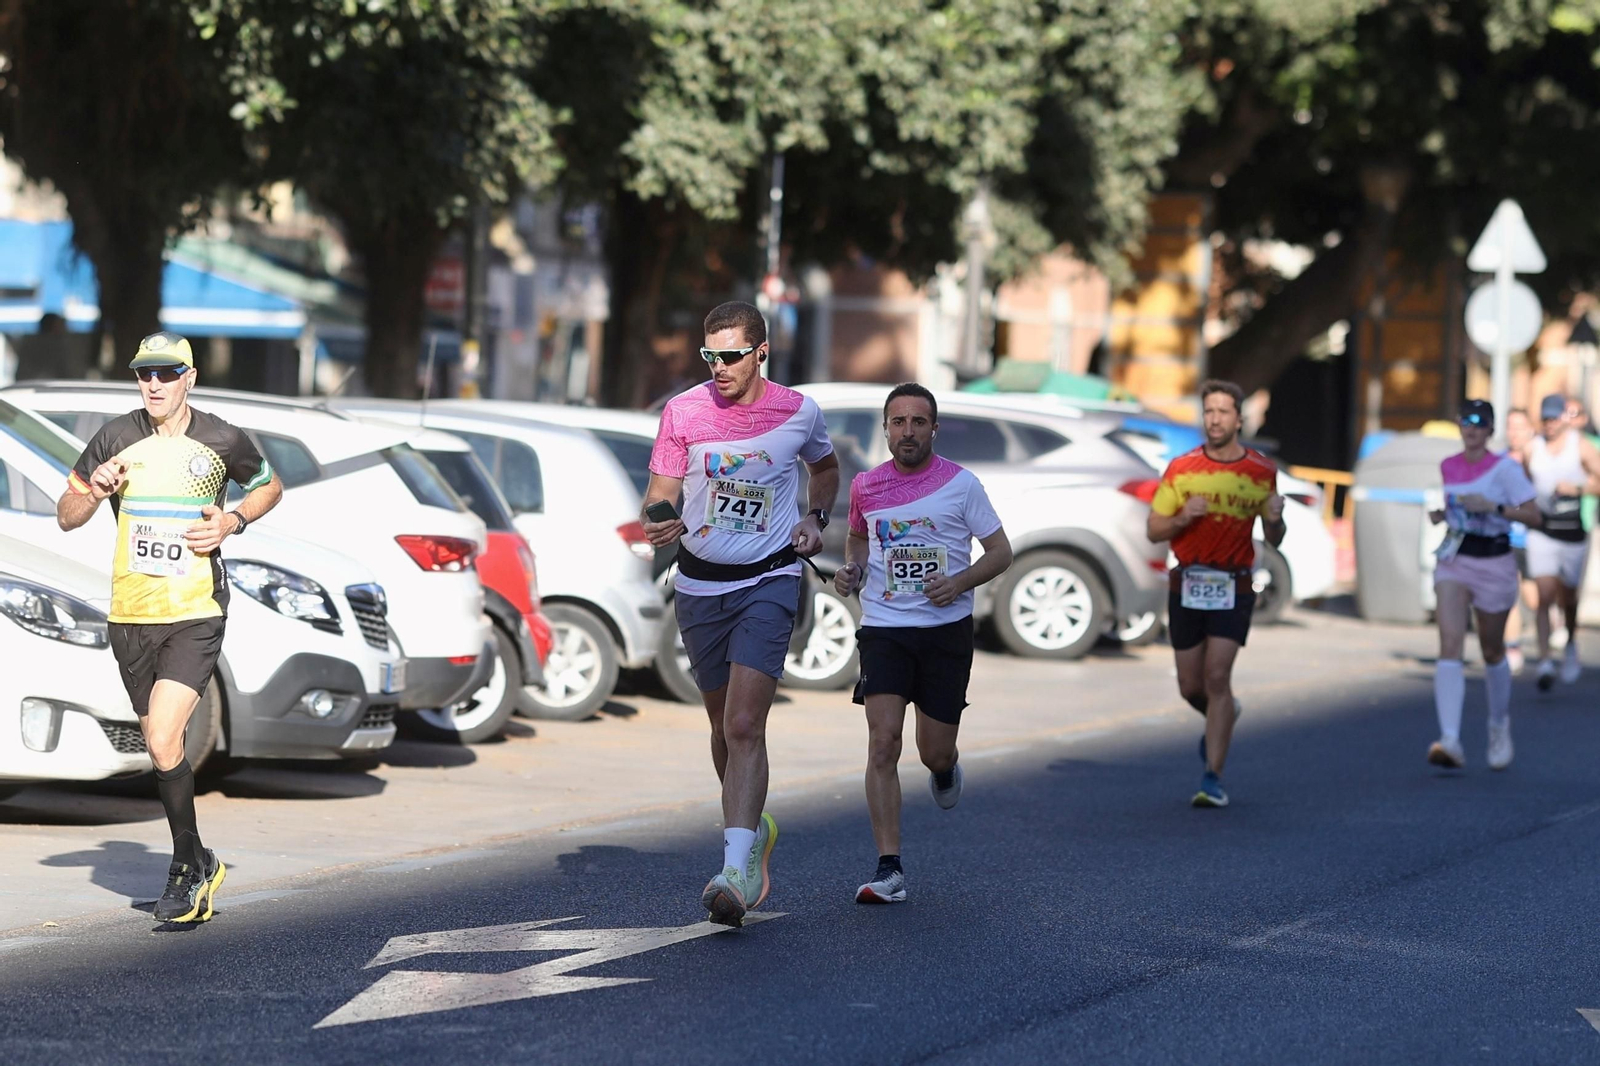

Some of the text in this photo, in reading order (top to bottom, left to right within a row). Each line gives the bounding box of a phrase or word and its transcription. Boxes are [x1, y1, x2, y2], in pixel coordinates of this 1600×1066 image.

[743, 490, 765, 498] 2025
[717, 495, 763, 518] 747
[137, 540, 182, 561] 560
[894, 562, 938, 579] 322
[1190, 584, 1226, 598] 625
